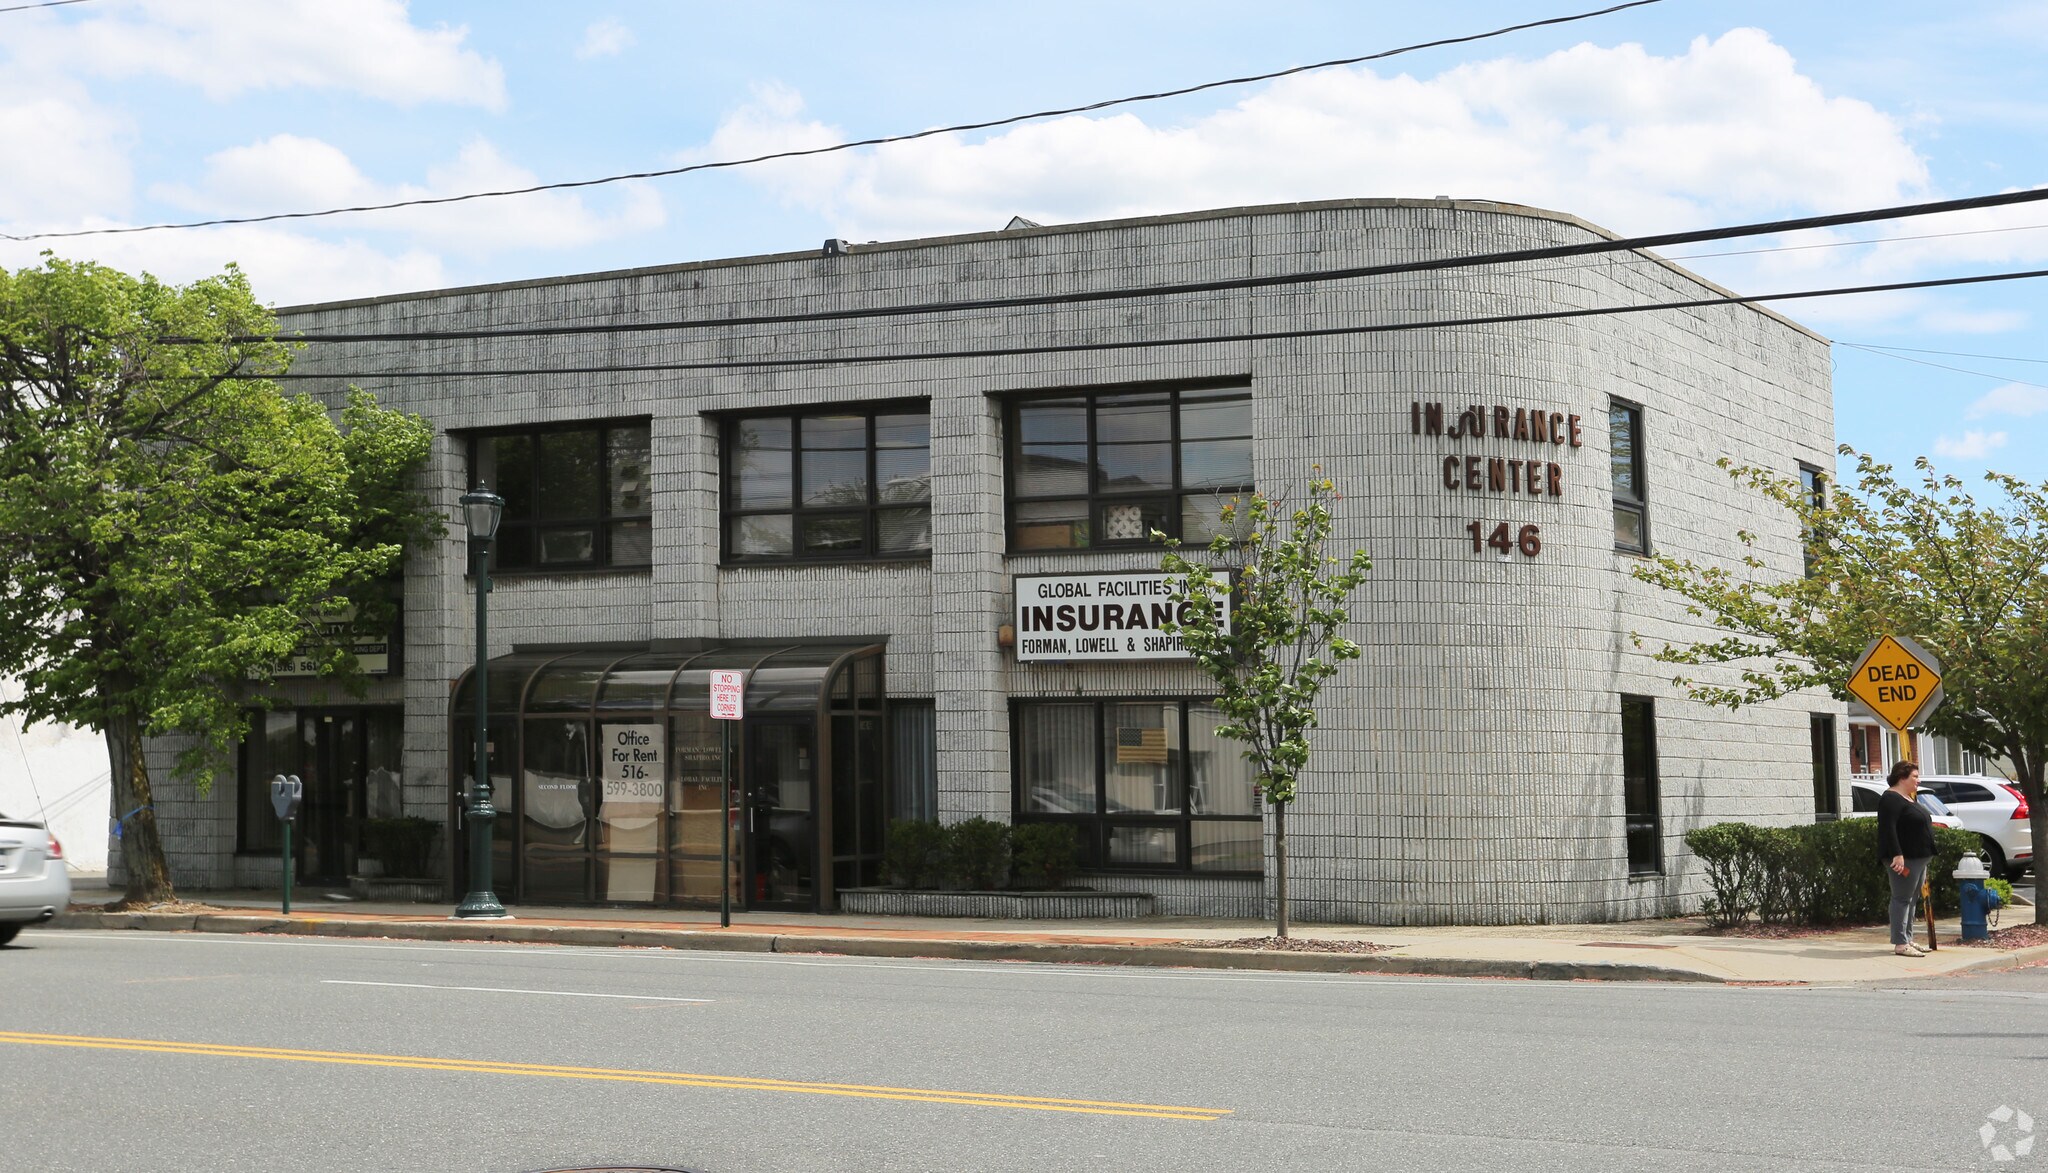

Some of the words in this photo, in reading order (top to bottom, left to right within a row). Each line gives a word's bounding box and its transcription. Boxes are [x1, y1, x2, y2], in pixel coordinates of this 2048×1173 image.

[1411, 401, 1582, 447] INSURANCE
[1443, 455, 1562, 496] CENTER
[1467, 520, 1542, 557] 146
[1038, 582, 1091, 599] GLOBAL
[1098, 579, 1172, 598] FACILITIES
[1021, 601, 1225, 632] INSURANCE
[1022, 638, 1071, 655] FORMAN,
[1076, 637, 1119, 653] LOWELL
[1127, 637, 1136, 652] &
[1144, 636, 1191, 652] SHAPIR
[721, 675, 733, 683] NO
[1868, 663, 1920, 683] DEAD
[713, 683, 741, 693] STOPPING
[1878, 685, 1917, 703] END
[717, 693, 729, 702] HERE
[730, 694, 737, 702] TO
[717, 703, 737, 712] CORNER
[617, 730, 650, 746] Office
[612, 748, 629, 762] For
[633, 748, 658, 762] Rent
[621, 765, 649, 779] 516-
[606, 782, 663, 797] 599-3800
